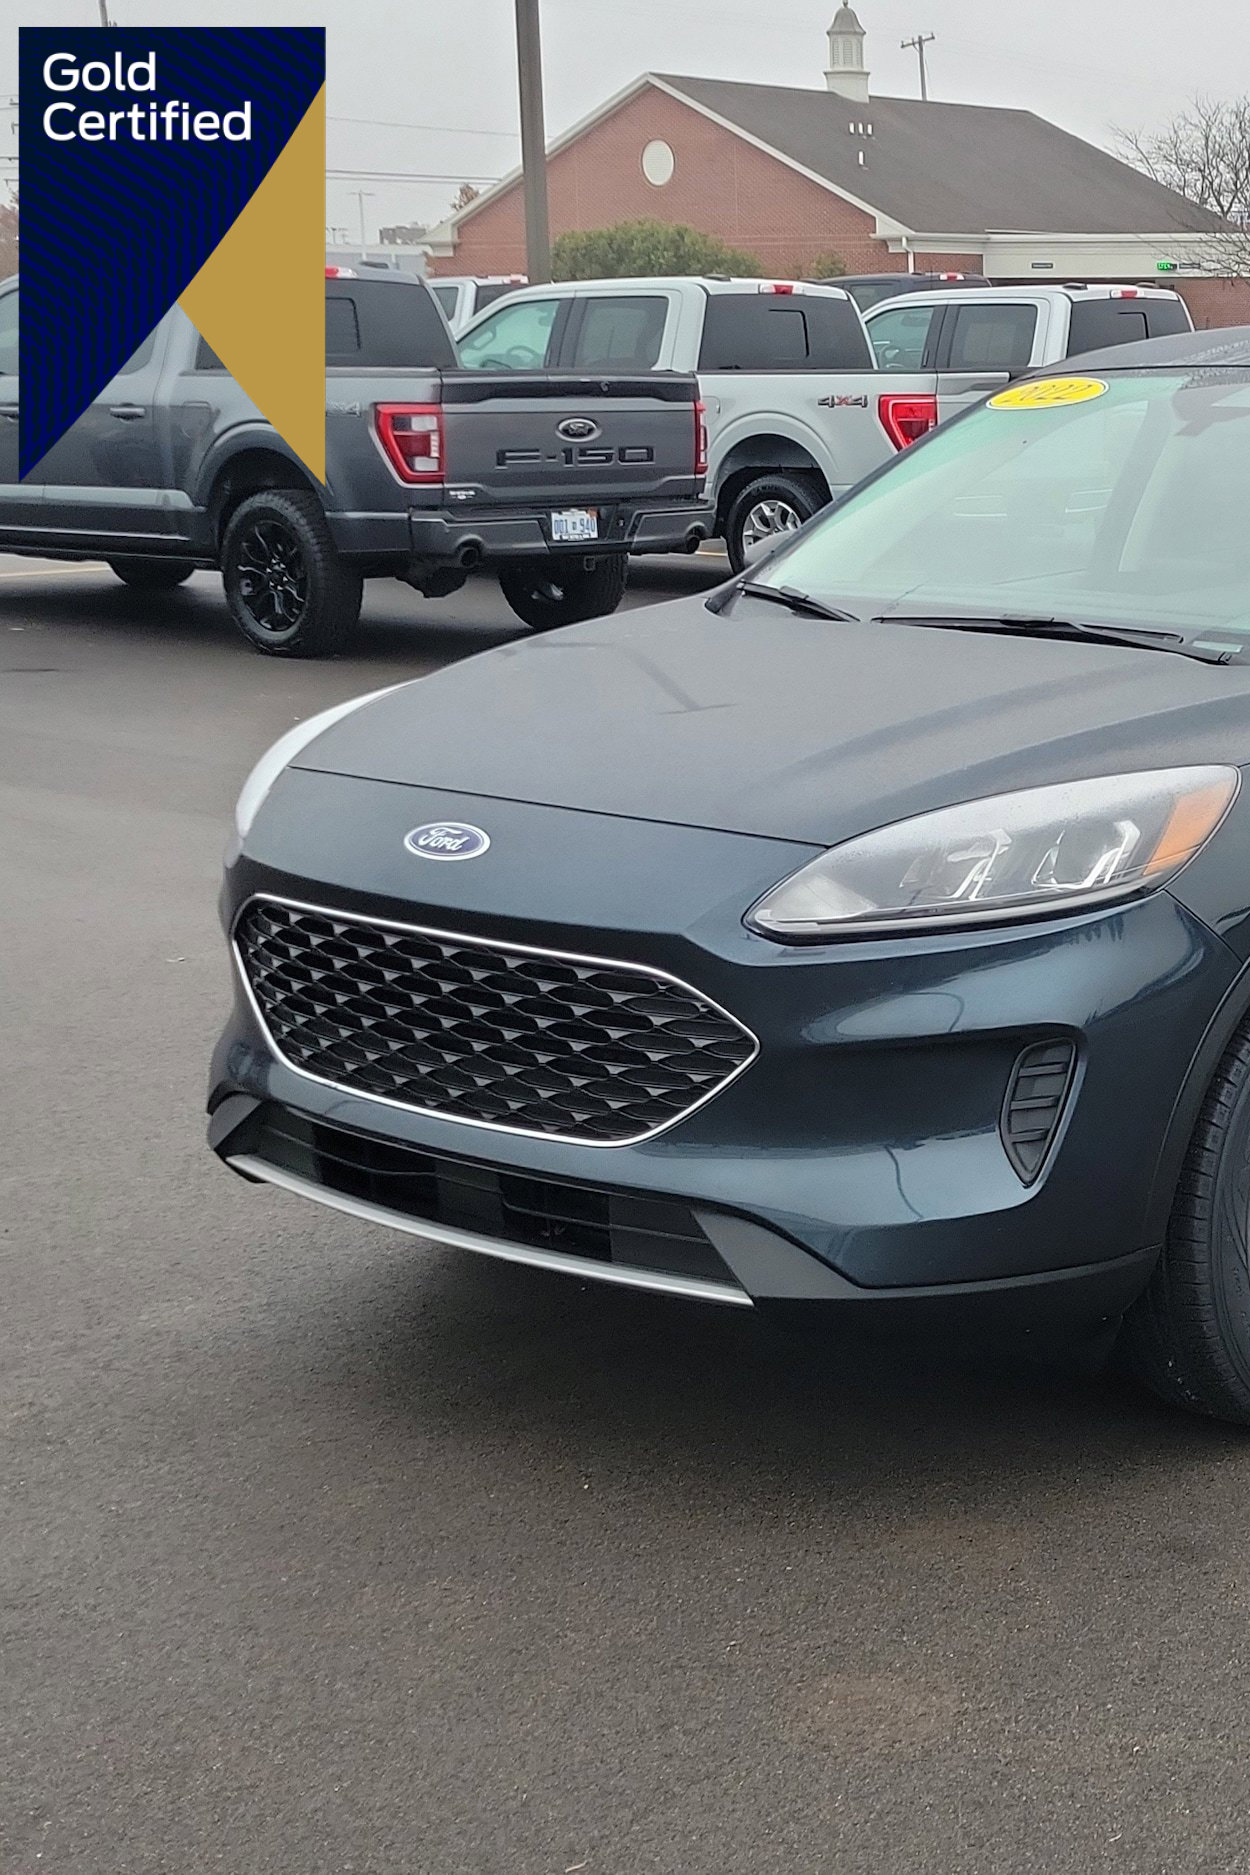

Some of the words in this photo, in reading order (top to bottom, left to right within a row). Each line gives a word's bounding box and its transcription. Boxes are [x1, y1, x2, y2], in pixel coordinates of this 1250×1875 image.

[1002, 382, 1094, 403] 2022
[495, 446, 655, 469] F-150
[418, 827, 470, 851] Ford
